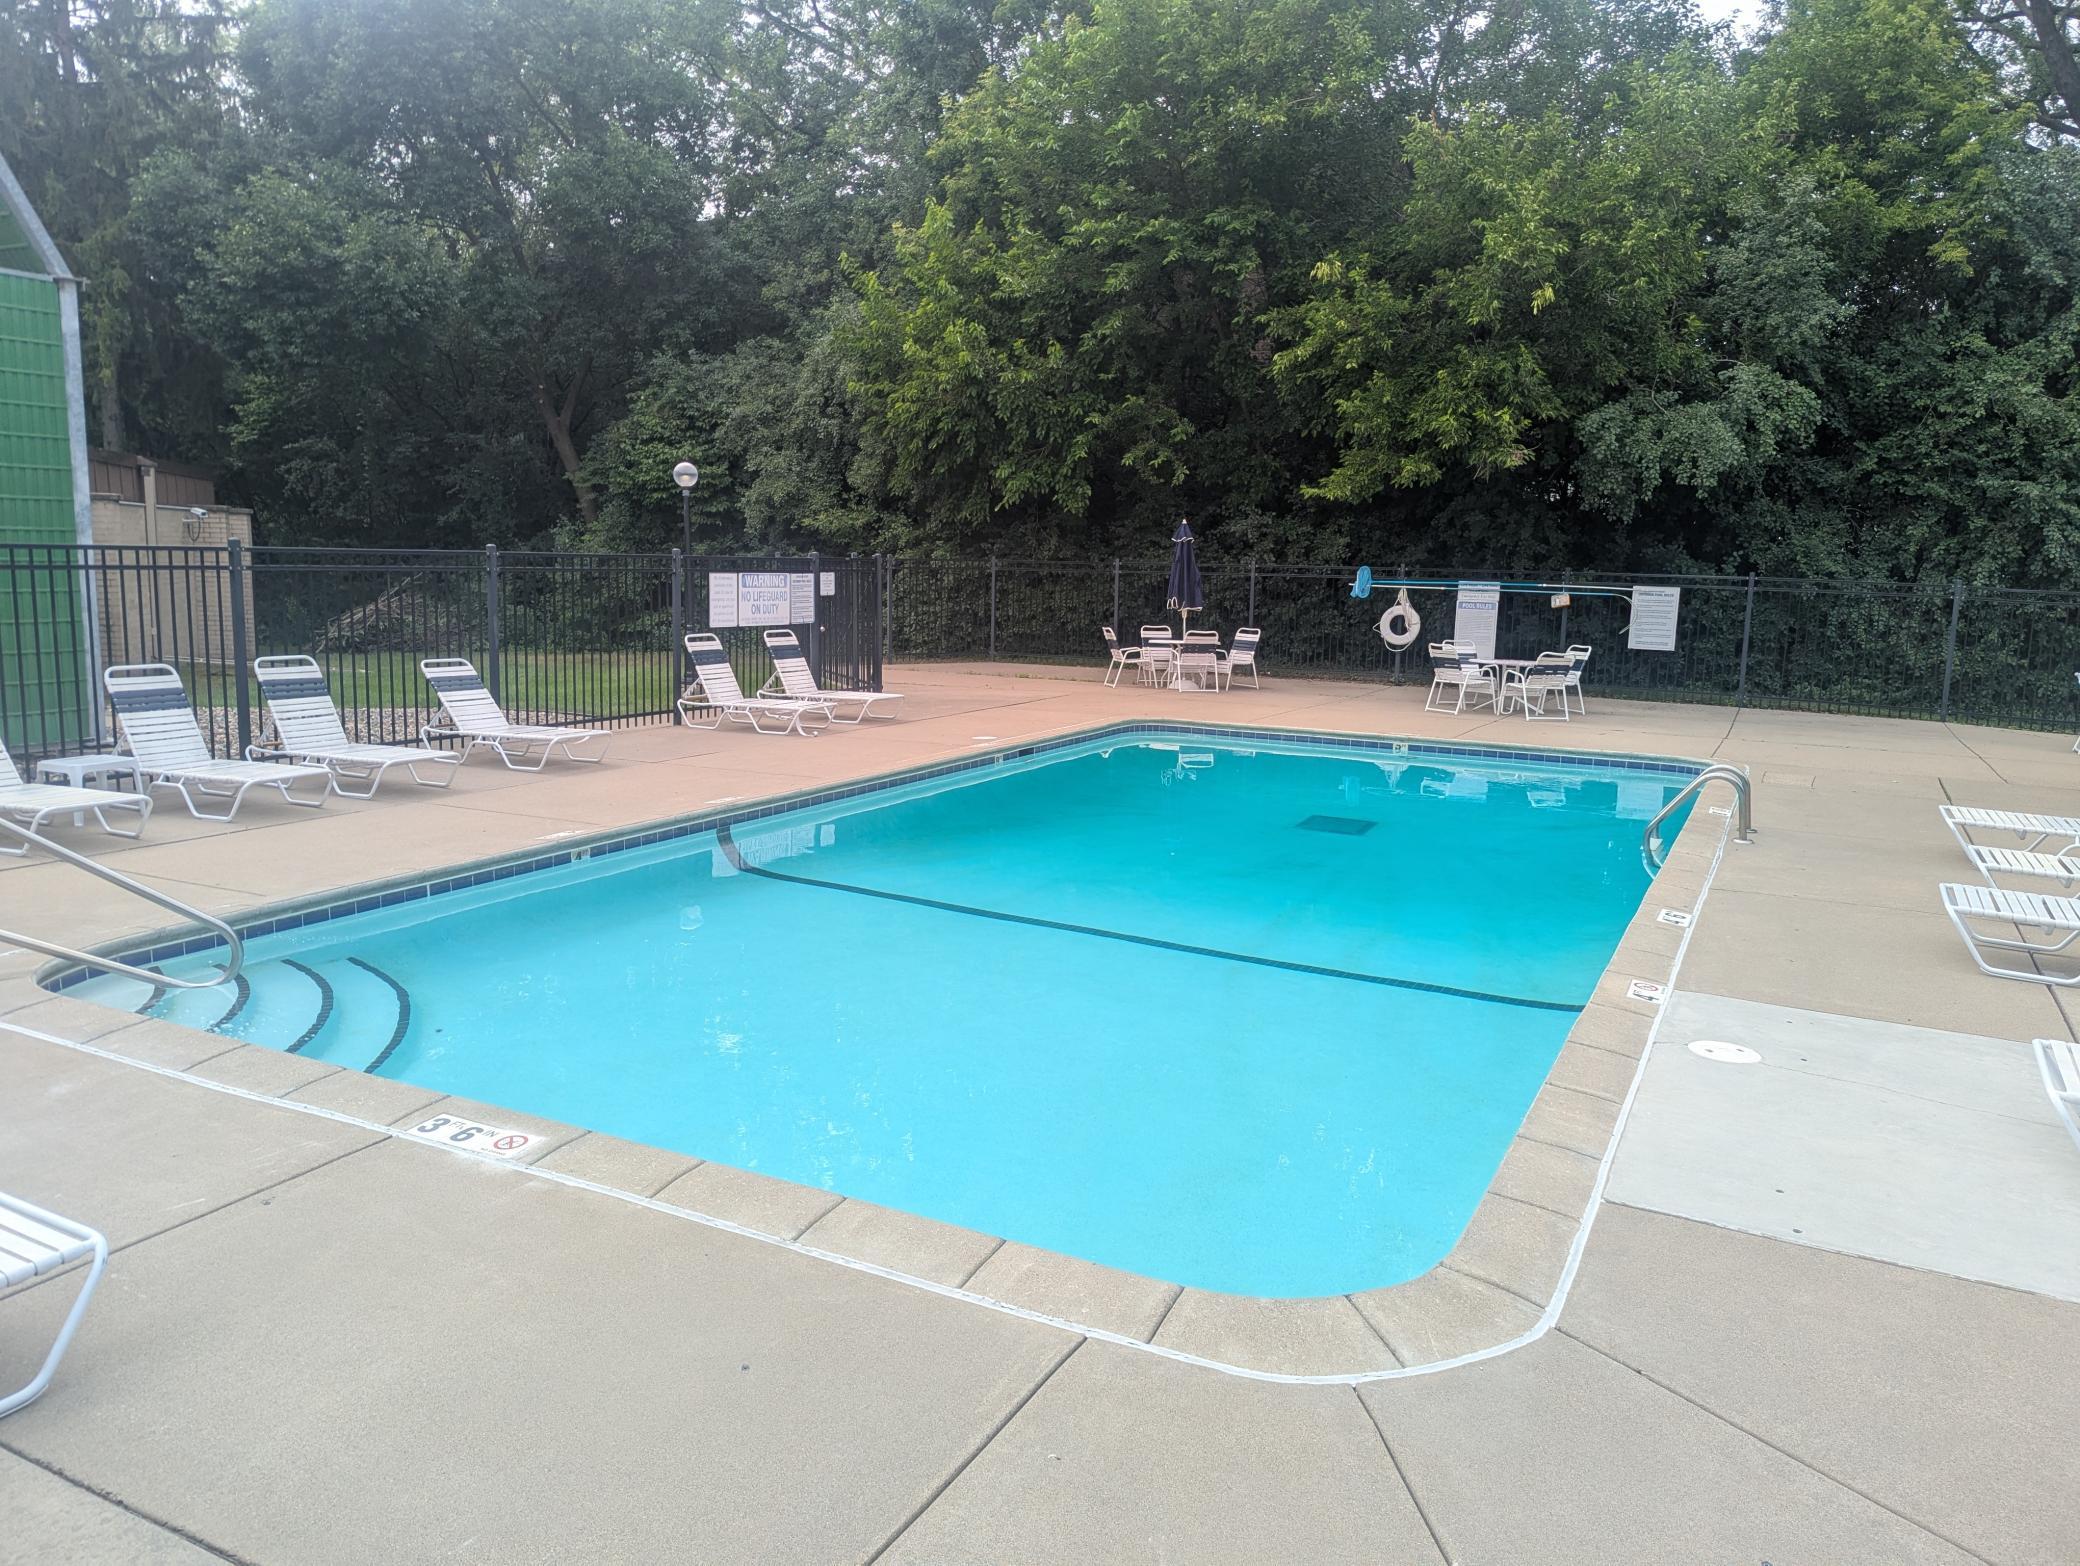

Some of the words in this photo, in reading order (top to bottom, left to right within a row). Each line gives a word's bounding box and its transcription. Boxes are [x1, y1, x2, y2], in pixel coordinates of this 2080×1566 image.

[745, 575, 785, 587] WARNING
[741, 591, 751, 602] NO
[752, 591, 788, 602] LIFEGUARD
[751, 603, 761, 614] ON
[762, 602, 779, 614] DUTY
[417, 1118, 452, 1133] 3
[449, 1126, 484, 1142] 6
